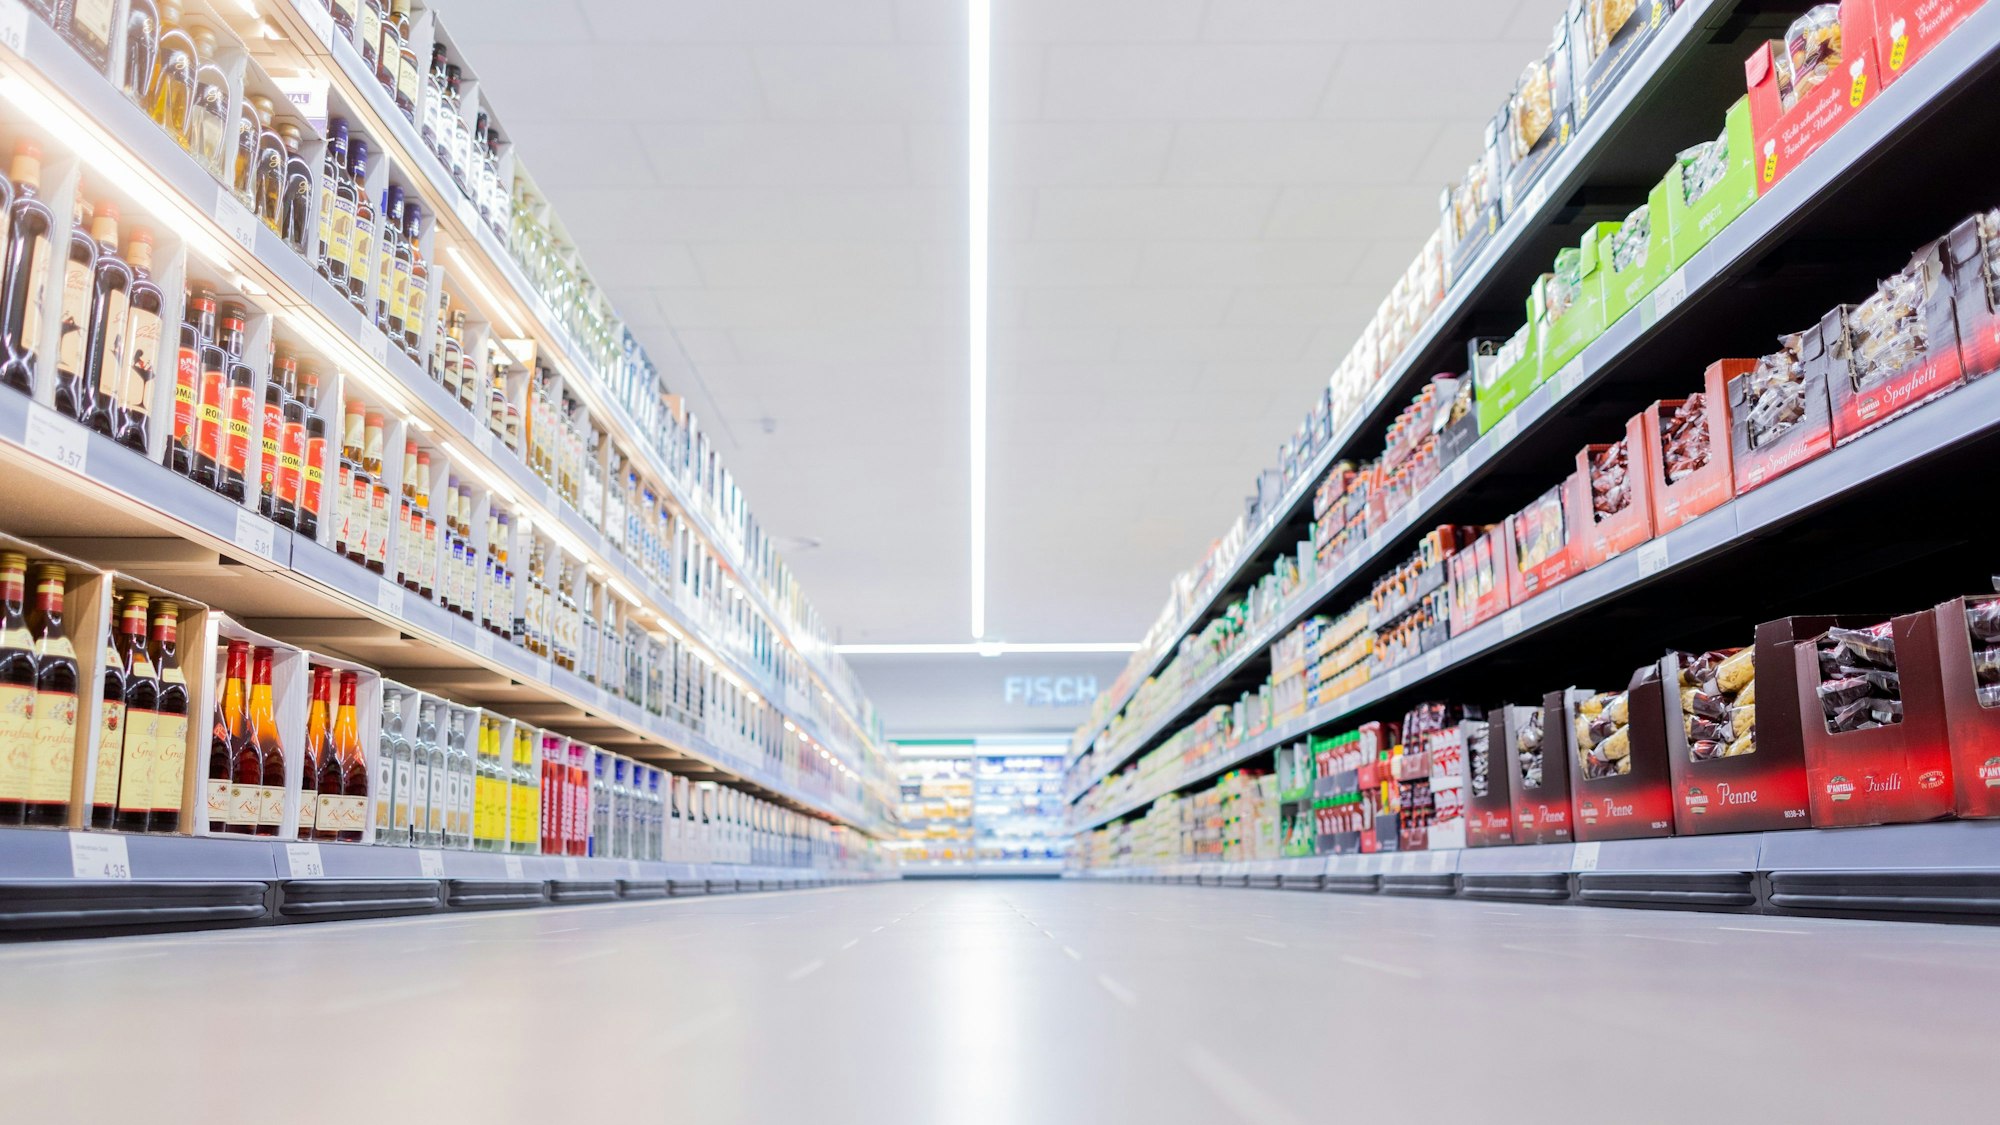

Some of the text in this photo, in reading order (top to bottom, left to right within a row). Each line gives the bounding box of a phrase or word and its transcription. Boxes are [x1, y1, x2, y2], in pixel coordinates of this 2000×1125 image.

[1782, 123, 1800, 143] Echt
[1883, 364, 1937, 408] Spaghetti
[58, 445, 82, 469] 3.57
[1767, 439, 1809, 472] Spaghetti
[255, 539, 270, 556] 5.81
[1005, 676, 1097, 703] FISCH
[1865, 773, 1902, 793] Fusilli
[1919, 770, 1944, 780] PRODOTTO
[1928, 779, 1944, 789] ITALIA
[1717, 783, 1758, 806] Penne
[1826, 783, 1855, 794] D'ANTELLI
[1539, 805, 1565, 824] Penne
[1603, 798, 1633, 818] Penne
[103, 863, 127, 879] 4.35
[307, 863, 321, 876] 5.81
